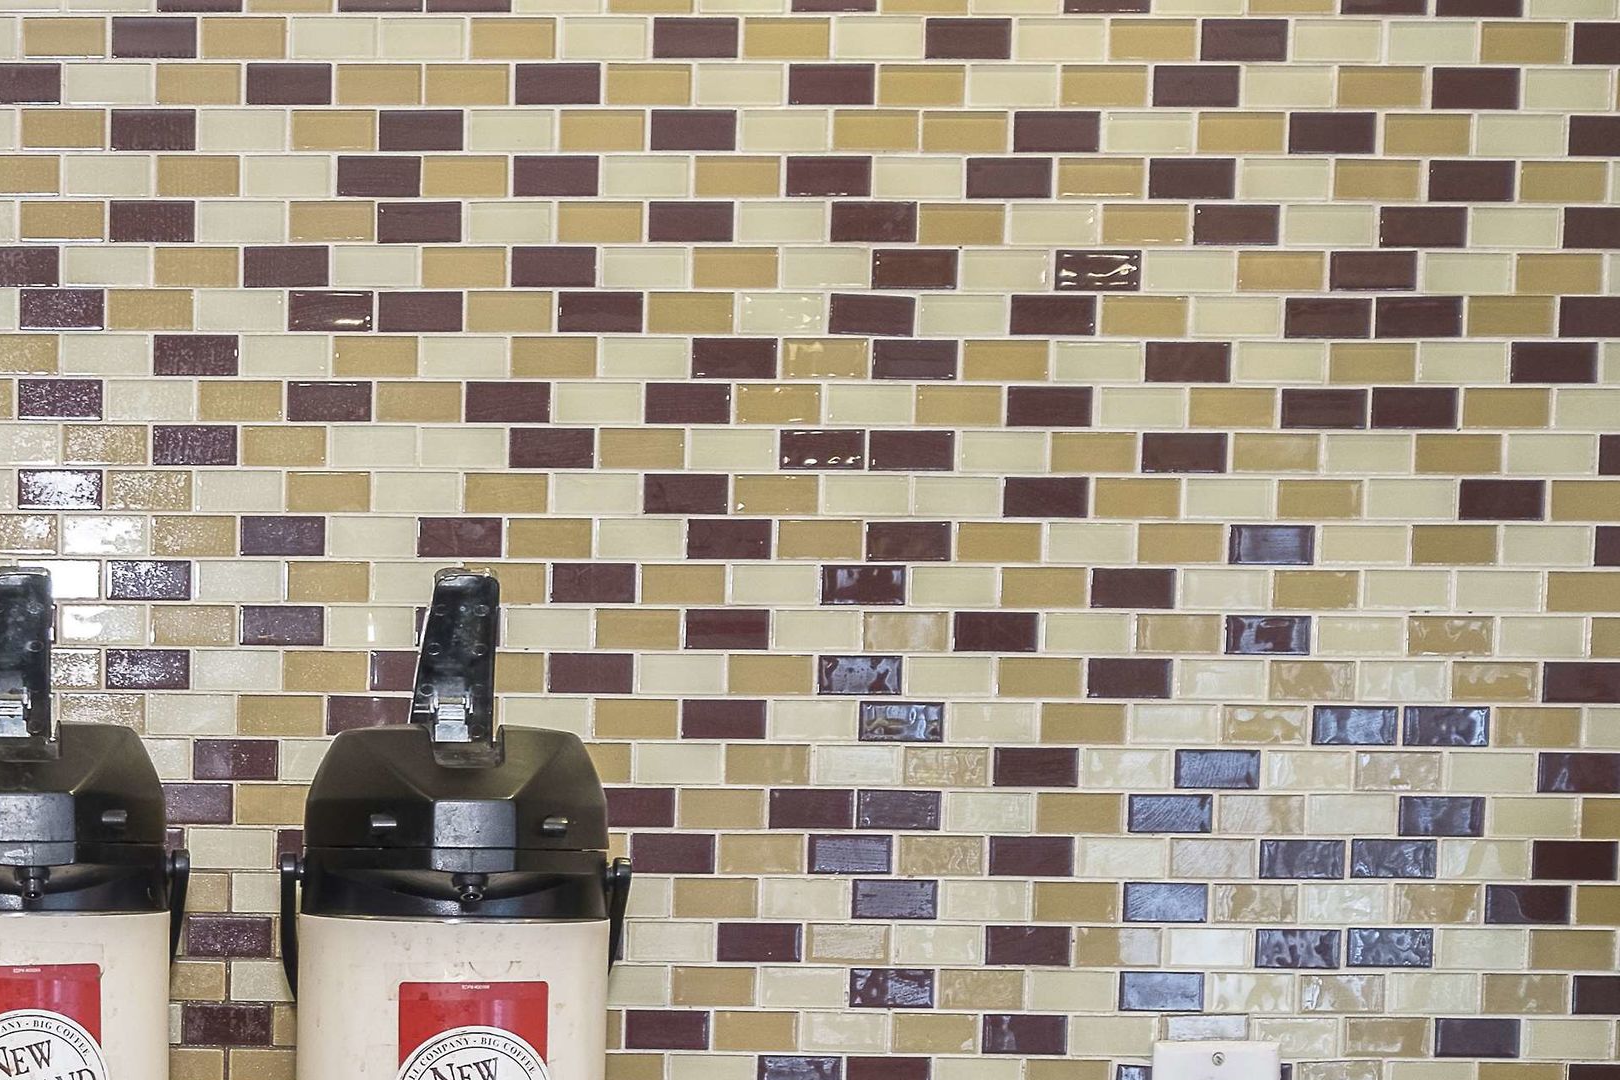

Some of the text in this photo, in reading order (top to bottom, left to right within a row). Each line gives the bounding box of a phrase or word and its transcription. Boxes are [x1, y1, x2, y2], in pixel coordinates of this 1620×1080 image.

[33, 1020, 52, 1029] BIG
[56, 1025, 91, 1056] COFFEE
[420, 1037, 470, 1066] COMPANY
[481, 1037, 500, 1047] BIG
[503, 1042, 536, 1074] COFFEE
